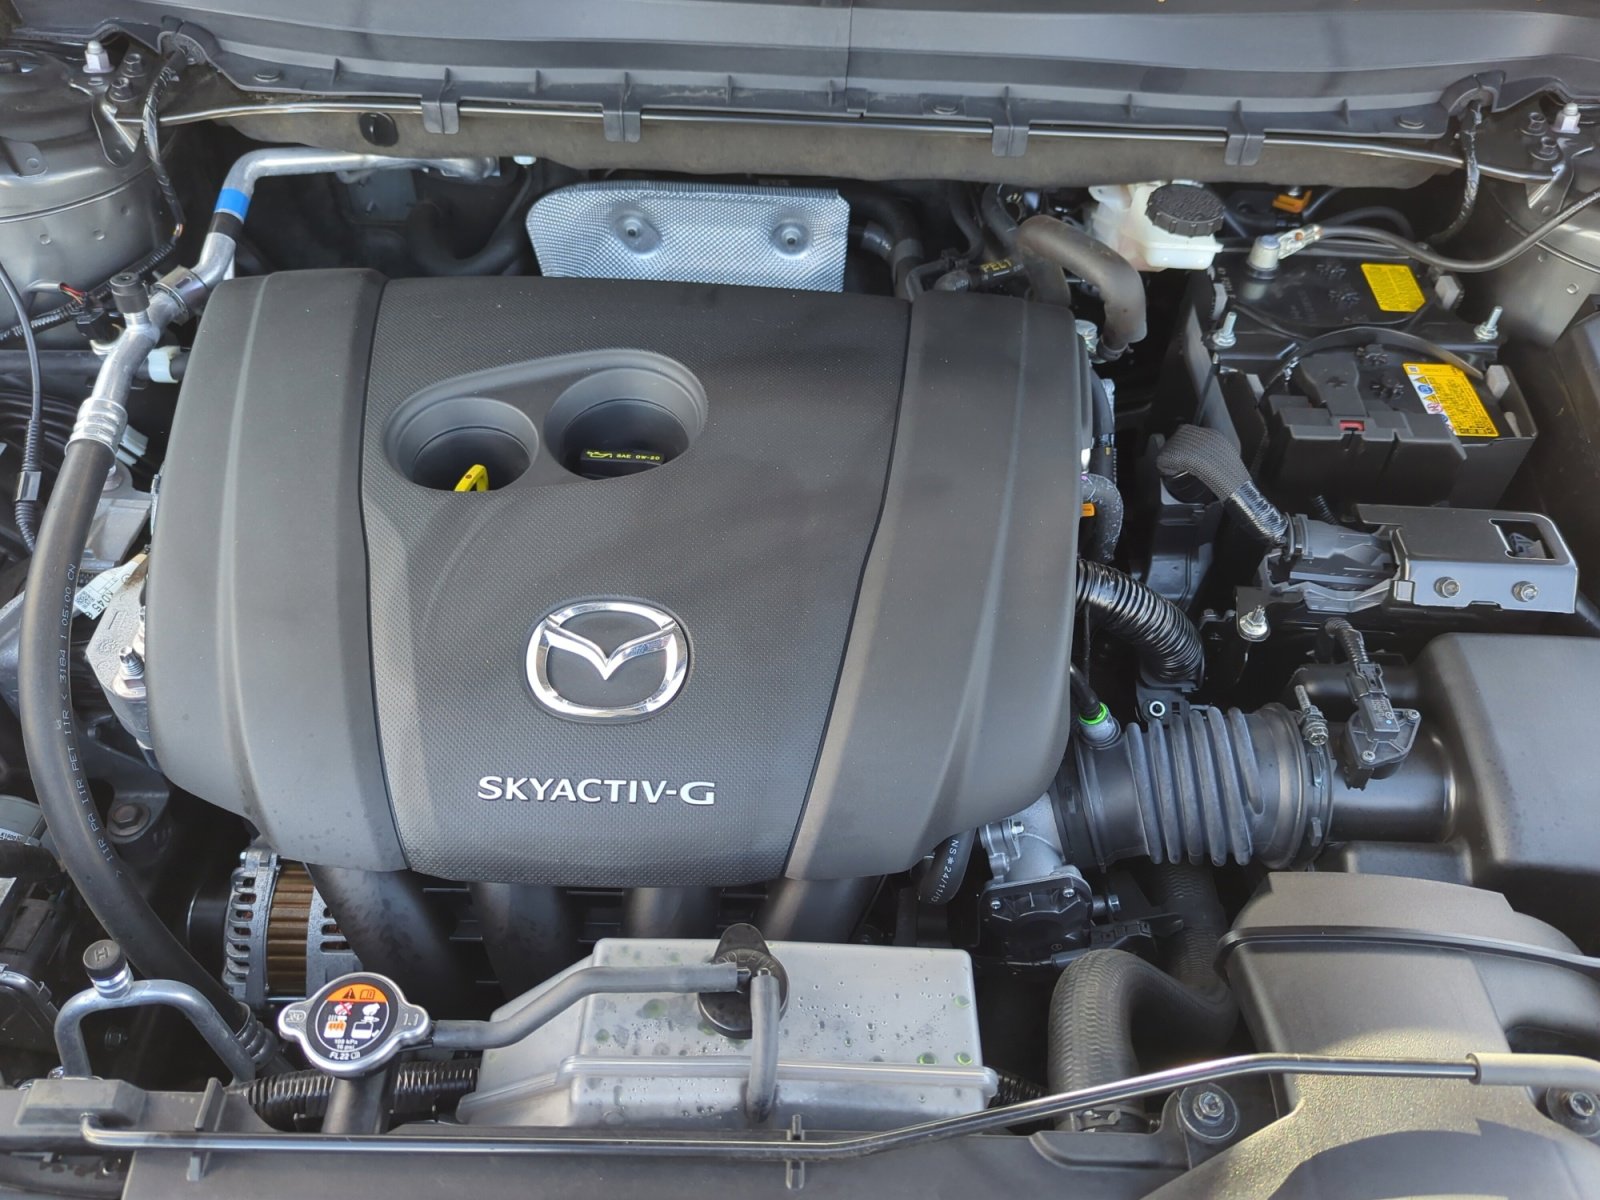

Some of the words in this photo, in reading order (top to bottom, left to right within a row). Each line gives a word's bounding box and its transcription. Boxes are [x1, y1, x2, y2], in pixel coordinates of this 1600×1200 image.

[68, 746, 80, 771] PET
[477, 775, 716, 806] SKYACTIV-G
[403, 1012, 419, 1026] 1.1
[329, 1051, 350, 1060] FL22
